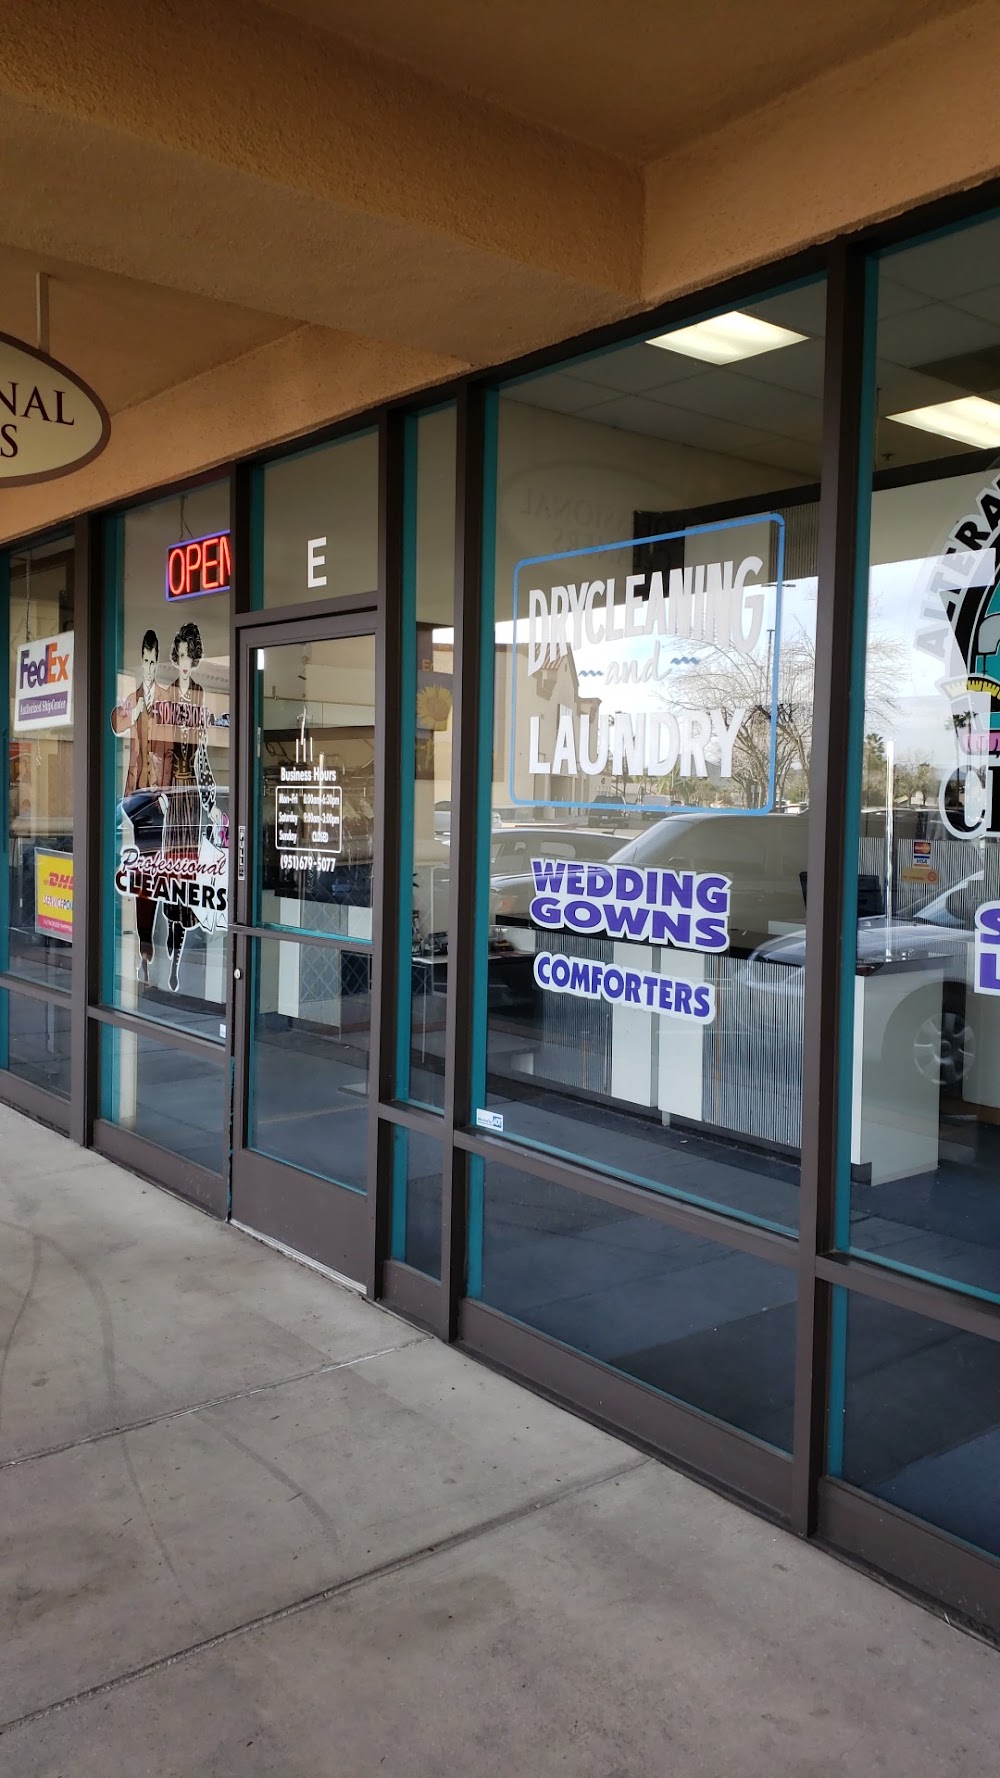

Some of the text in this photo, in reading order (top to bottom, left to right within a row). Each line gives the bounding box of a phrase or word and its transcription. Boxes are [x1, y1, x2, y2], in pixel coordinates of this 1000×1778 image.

[307, 537, 327, 588] E
[916, 478, 1000, 658] ALTERA
[528, 556, 765, 677] DRYCLEANING
[19, 642, 70, 690] FedEx
[604, 640, 673, 686] and
[529, 703, 748, 778] LAUNDRY
[280, 767, 337, 782] Business Hours
[278, 811, 299, 826] Saturday
[279, 830, 329, 844] Sunday CLOSED
[121, 848, 227, 876] Professional
[116, 867, 228, 911] CLEANERS
[532, 861, 728, 913] WEDDING
[531, 897, 728, 948] GOWNS
[537, 956, 710, 1018] COMFORTERS
